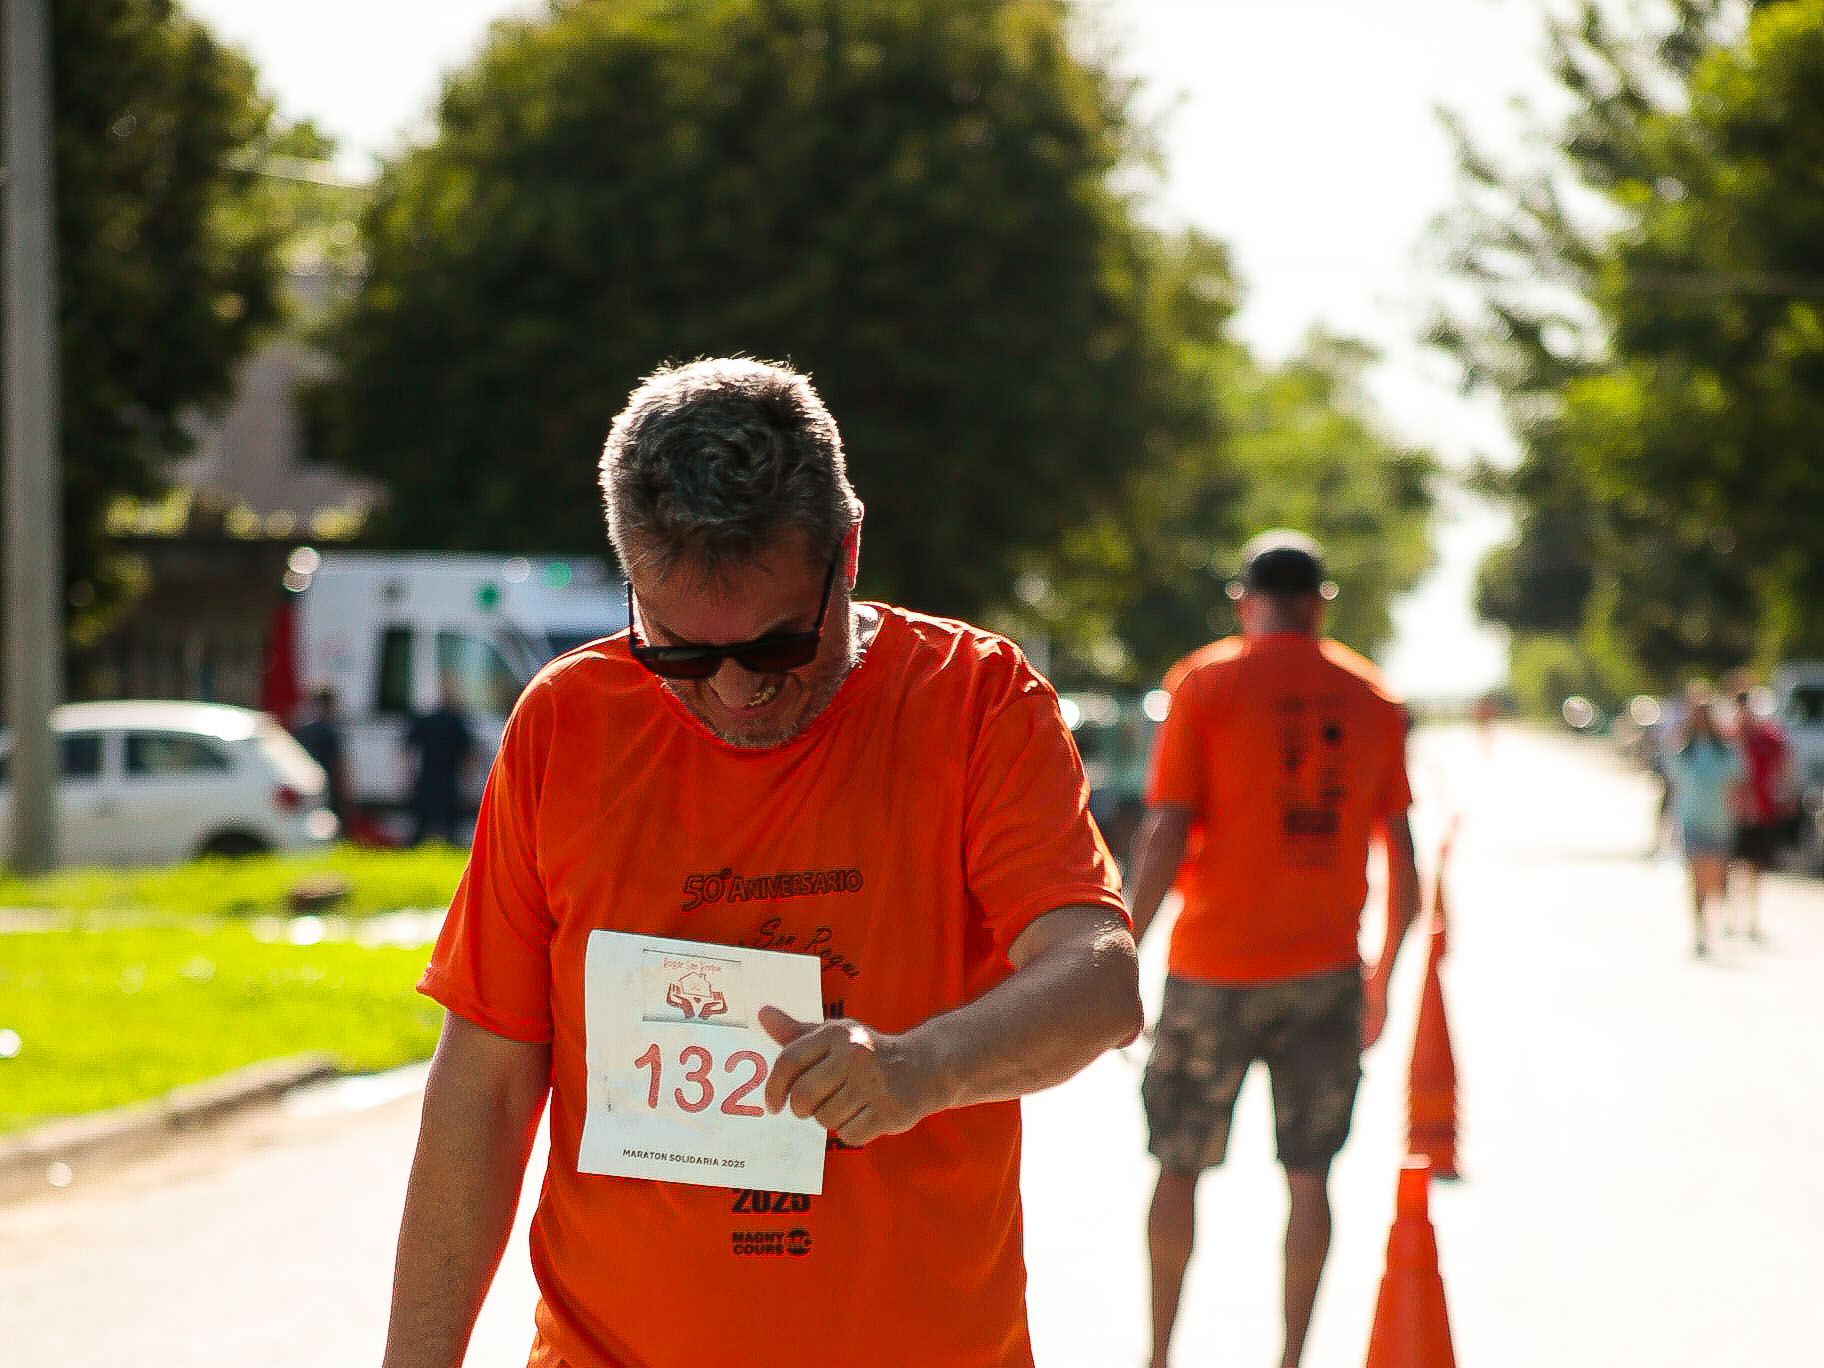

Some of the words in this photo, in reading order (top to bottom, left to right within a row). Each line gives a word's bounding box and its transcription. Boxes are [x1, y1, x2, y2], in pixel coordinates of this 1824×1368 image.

[728, 869, 864, 903] ANIVERSARIO
[634, 1043, 768, 1118] 132
[622, 1148, 667, 1161] MARATON
[669, 1153, 719, 1166] SOLIDARIA
[721, 1158, 745, 1169] 2025
[731, 1188, 811, 1214] 2025
[732, 1231, 784, 1243] MAGNY
[733, 1244, 784, 1255] COURS
